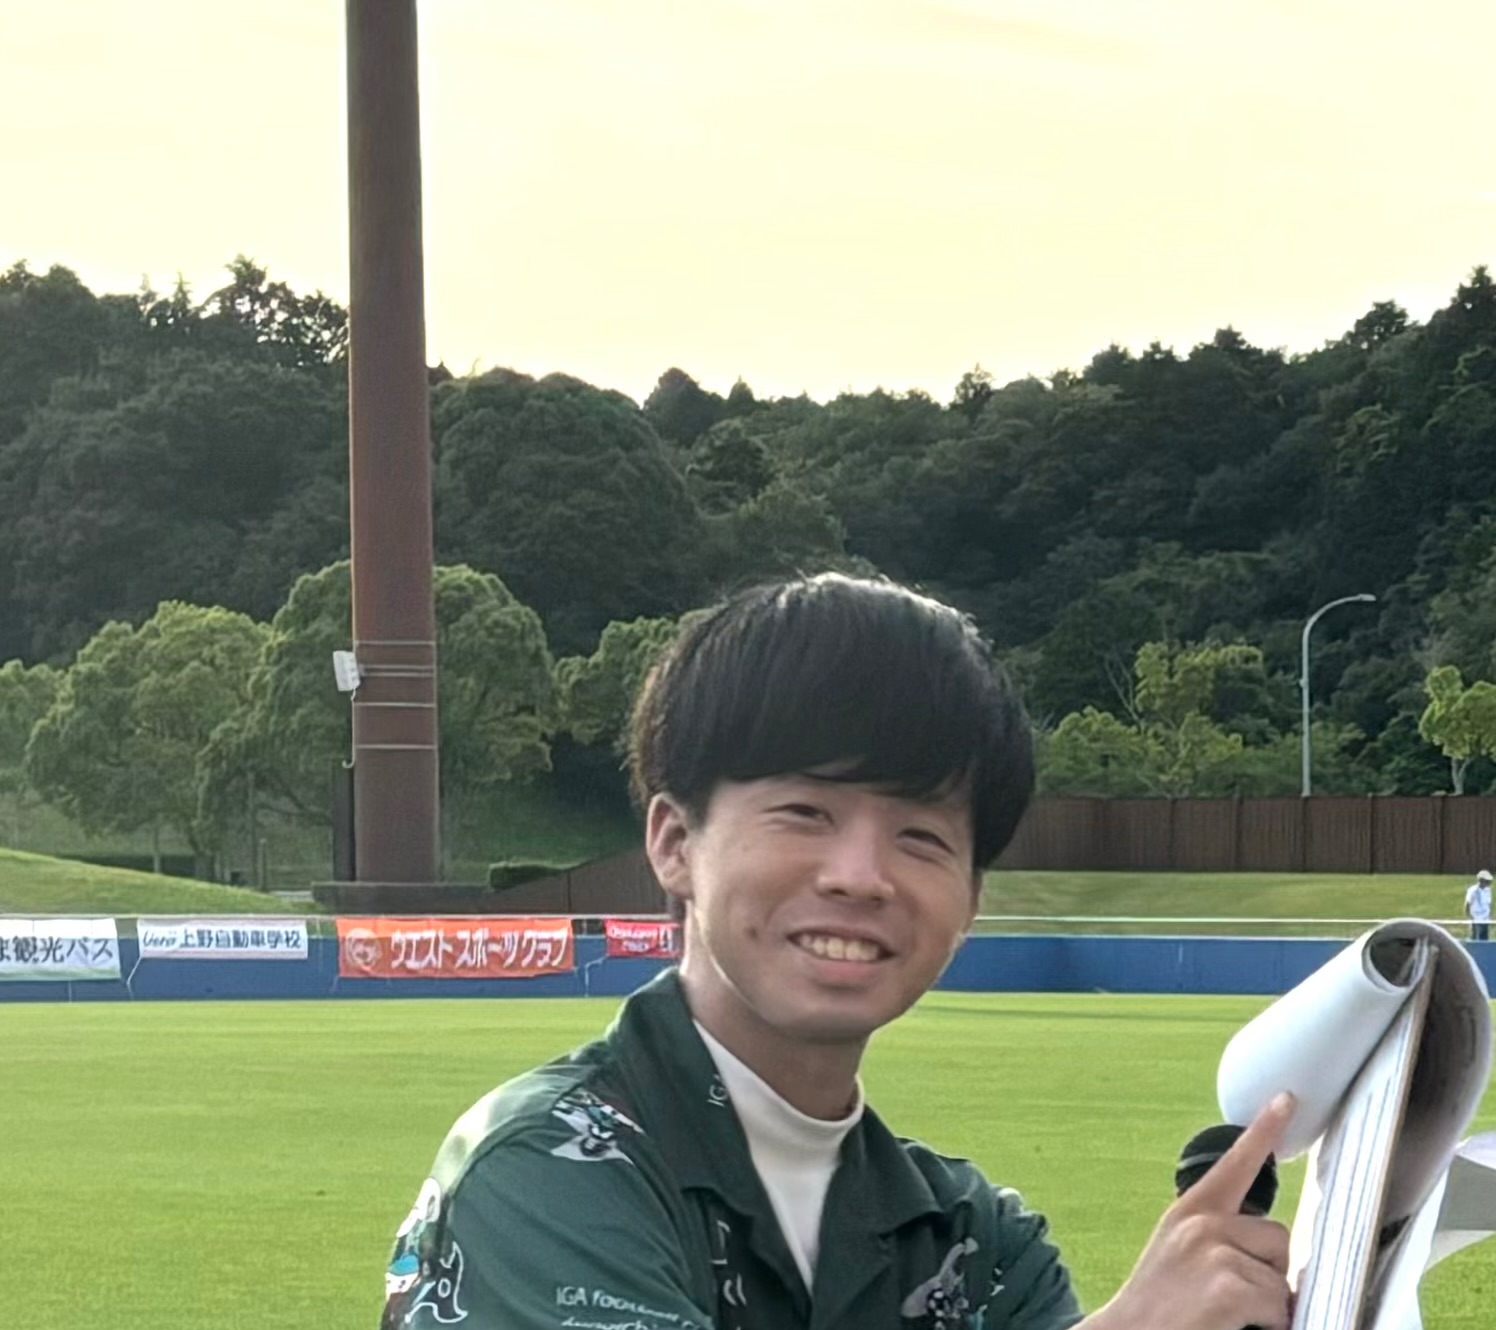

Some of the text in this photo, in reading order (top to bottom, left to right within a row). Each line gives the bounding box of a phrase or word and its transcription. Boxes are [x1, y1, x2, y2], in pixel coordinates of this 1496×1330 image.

[180, 928, 301, 949] 上野自動車学校
[707, 1073, 728, 1107] IG
[556, 1286, 588, 1306] IGA
